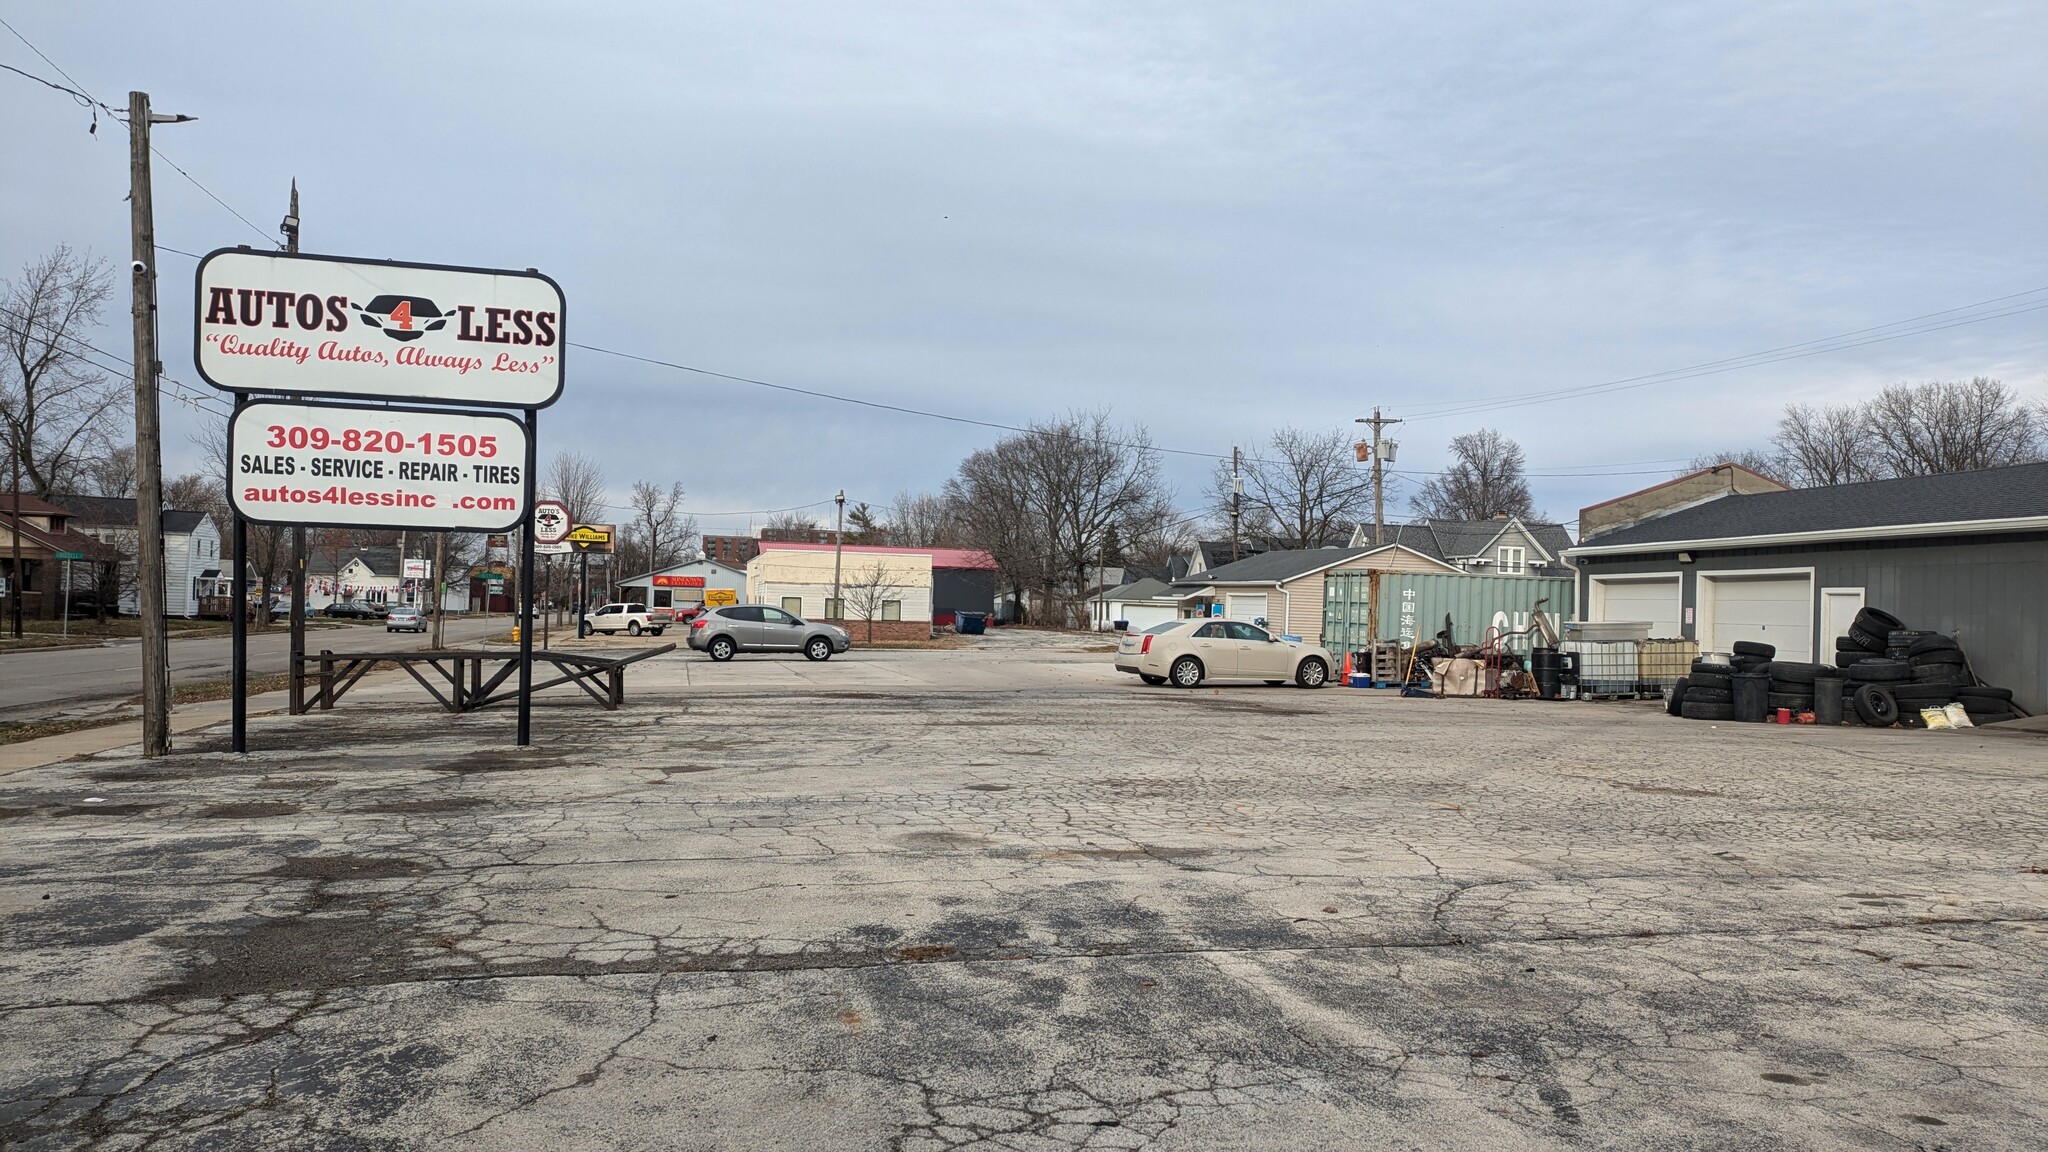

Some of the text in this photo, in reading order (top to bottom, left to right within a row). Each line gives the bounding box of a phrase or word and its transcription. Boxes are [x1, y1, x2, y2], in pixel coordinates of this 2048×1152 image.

[205, 287, 556, 347] AUTOS 4 LESS
[317, 340, 389, 367] Autos,
[395, 346, 482, 374] Always
[266, 425, 497, 458] 309-820-1505
[240, 454, 296, 476] SALES
[310, 457, 383, 479] SERVICE
[399, 461, 458, 482] REPAIR
[473, 464, 520, 484] TIRES
[244, 485, 516, 511] autos4lessinc .com
[544, 514, 552, 525] 4
